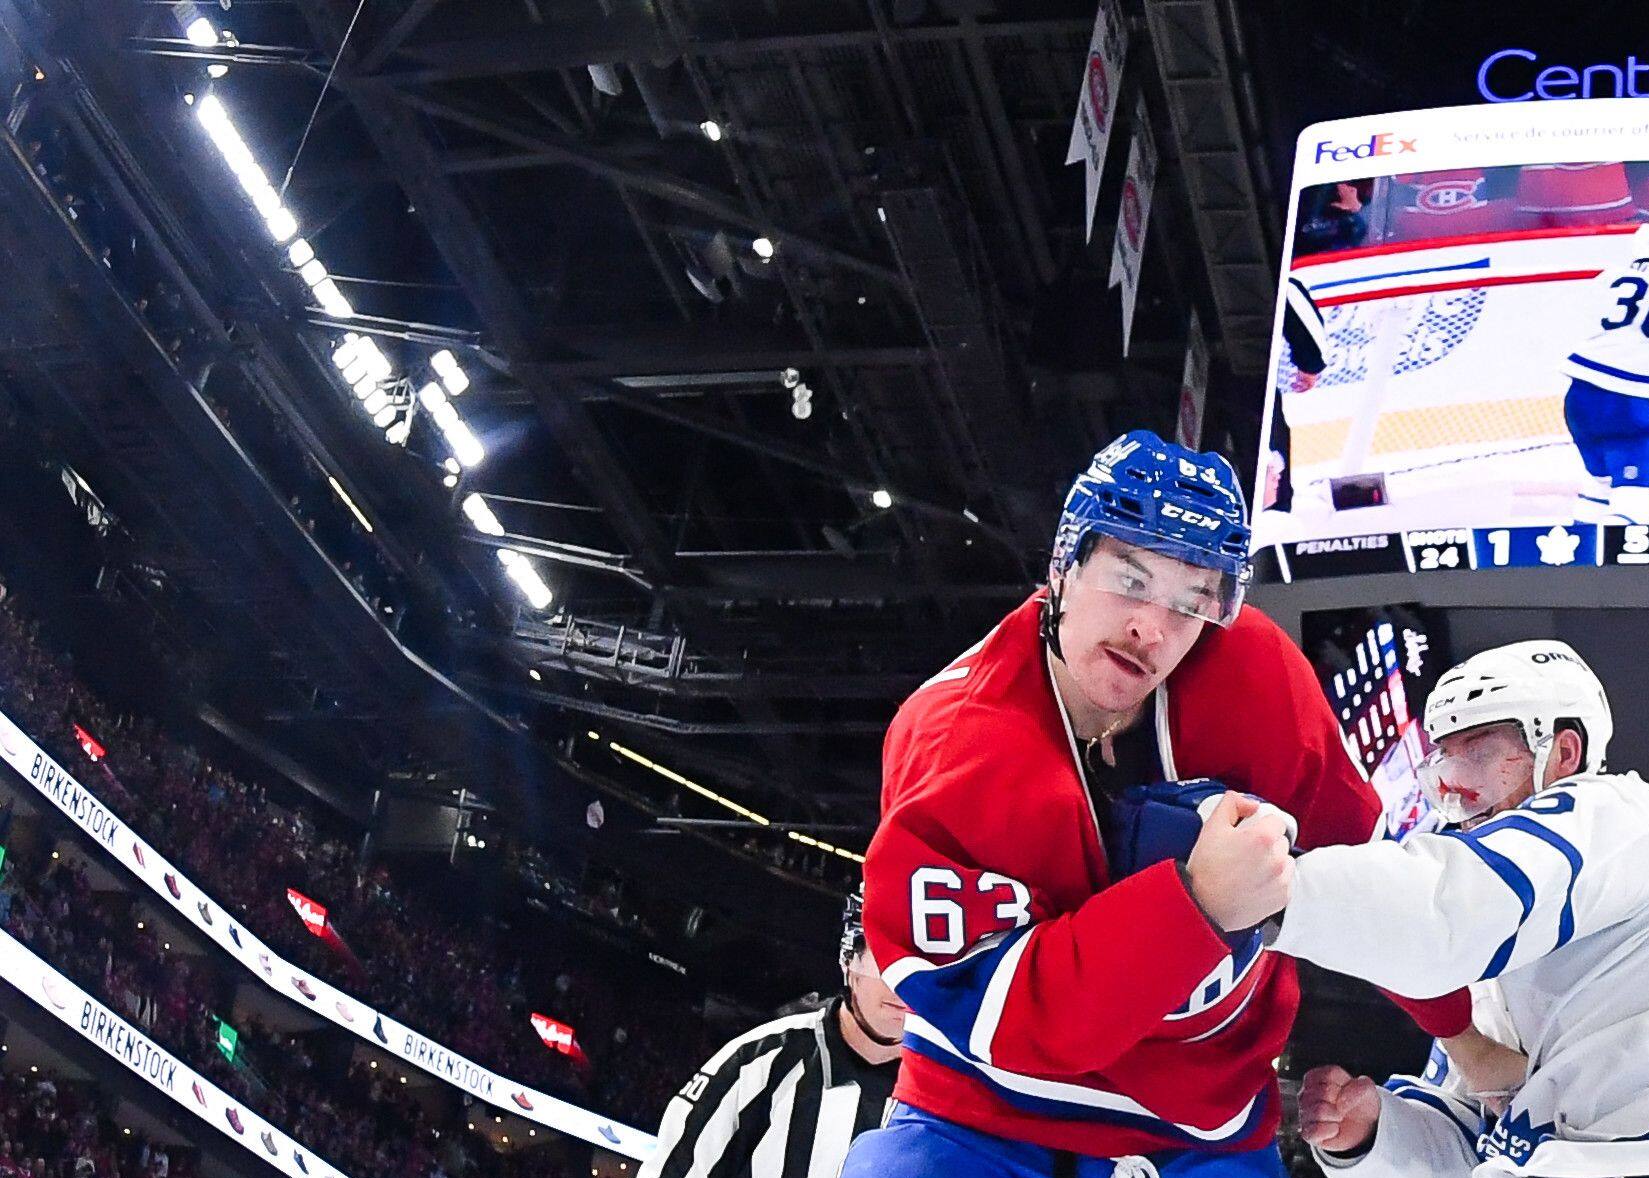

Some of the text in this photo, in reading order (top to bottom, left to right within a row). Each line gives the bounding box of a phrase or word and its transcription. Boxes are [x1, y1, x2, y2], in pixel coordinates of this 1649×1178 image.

[1315, 133, 1417, 164] FedEx
[1160, 502, 1221, 531] CCM
[1295, 535, 1390, 556] PENALTIES
[1420, 546, 1460, 569] 24
[1488, 529, 1511, 566] 1
[30, 752, 118, 847] BIRKENSTOCK
[909, 866, 1033, 955] 63
[81, 1000, 177, 1092] BIRKENSTOCK
[403, 1032, 495, 1098] BIRKENSTOCK
